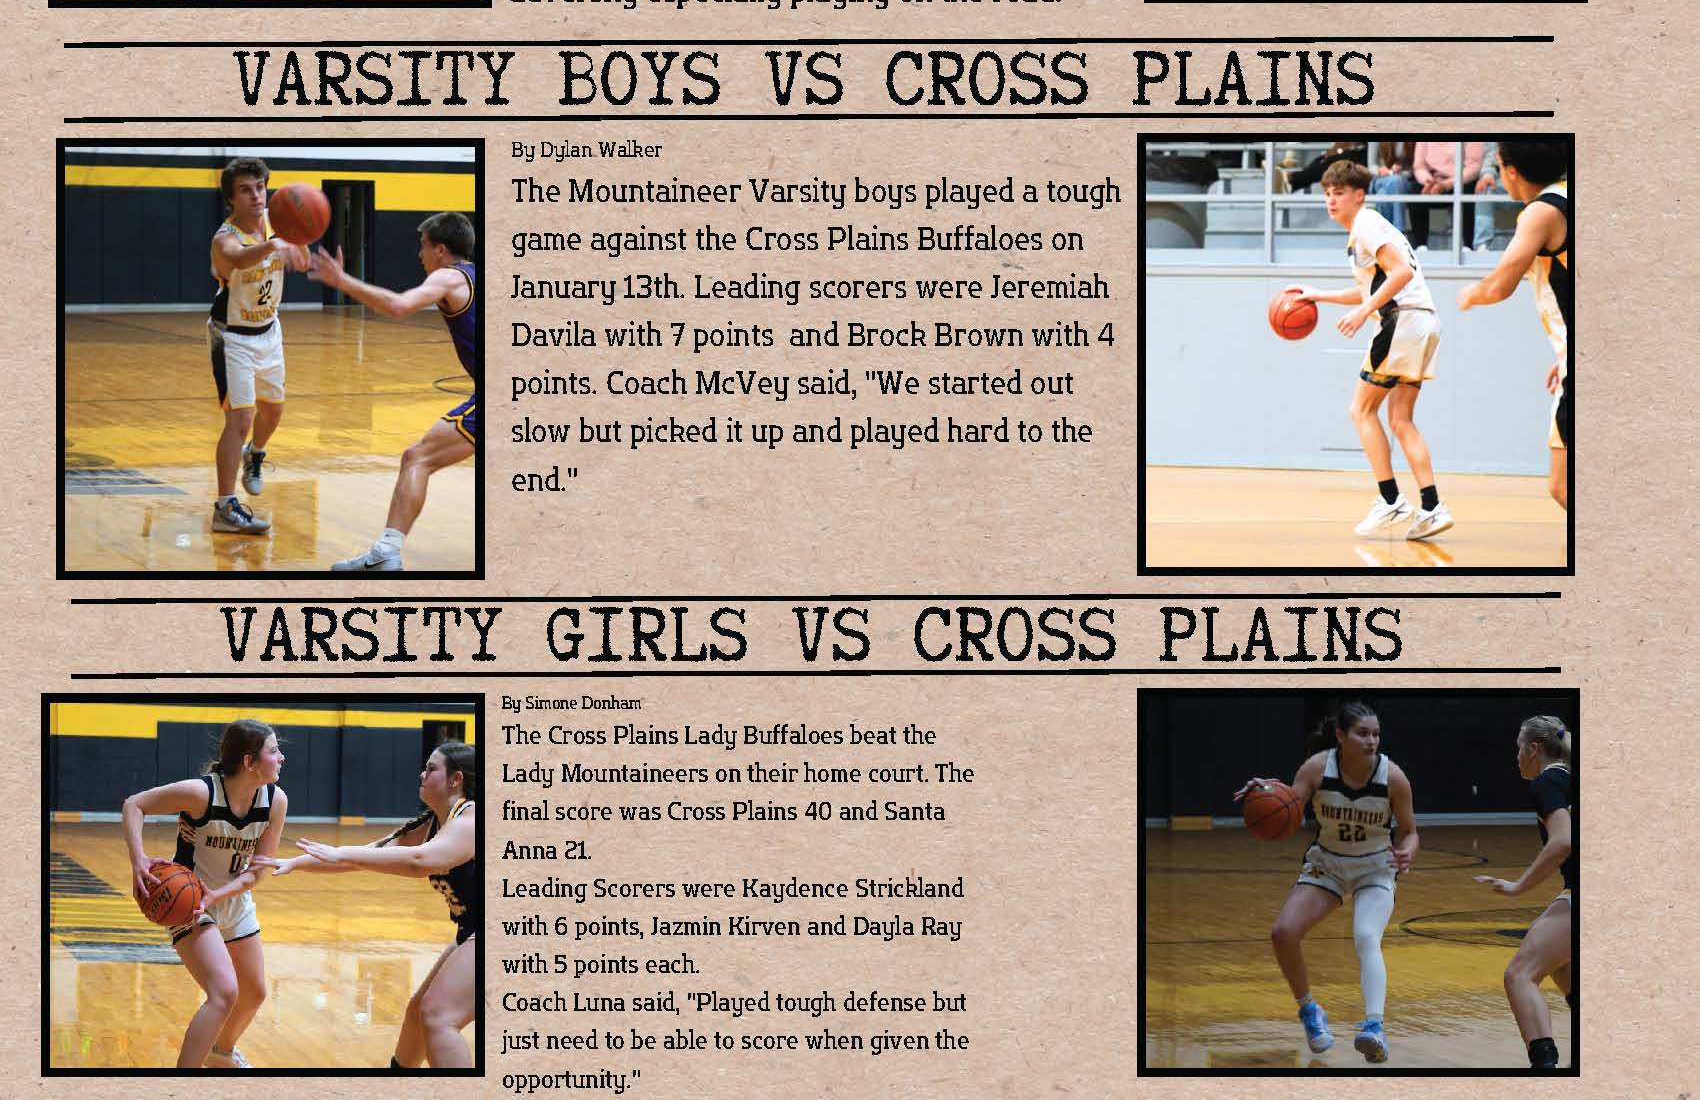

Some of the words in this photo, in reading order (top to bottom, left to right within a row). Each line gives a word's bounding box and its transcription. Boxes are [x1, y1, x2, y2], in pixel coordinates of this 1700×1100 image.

[232, 50, 516, 107] VARSITY
[557, 50, 721, 106] BOYS
[764, 50, 844, 107] VS
[885, 50, 1089, 107] CROSS
[1131, 50, 1375, 107] PLAINS
[511, 141, 536, 163] By
[540, 139, 593, 163] Dylan
[597, 139, 663, 158] Walker
[511, 176, 561, 203] The
[568, 176, 742, 203] Mountaineer
[748, 176, 847, 210] Varsity
[854, 176, 917, 210] boys
[925, 176, 1015, 210] played
[1022, 184, 1039, 203] a
[1046, 176, 1122, 210] tough
[510, 274, 617, 306] January
[623, 272, 685, 299] 13th.
[694, 272, 801, 306] Leading
[809, 280, 907, 299] scorers
[915, 280, 983, 299] were
[990, 272, 1110, 299] Jeremiah
[511, 368, 597, 402] points.
[606, 368, 688, 395] Coach
[695, 370, 790, 402] McVey
[797, 368, 857, 401] said,
[865, 370, 920, 395] "We
[928, 368, 1023, 395] started
[1030, 372, 1074, 395] out
[511, 465, 578, 492] end."
[219, 606, 503, 663] VARSITY
[546, 606, 748, 663] GIRLS
[791, 606, 871, 663] VS
[913, 606, 1117, 663] CROSS
[1158, 606, 1403, 663] PLAINS
[501, 695, 522, 714] By
[525, 695, 578, 710] Simone
[581, 694, 642, 710] Donham
[501, 723, 542, 745] The
[548, 725, 607, 745] Cross
[613, 723, 679, 745] Plains
[684, 723, 738, 751] Lady
[743, 723, 844, 745] Buffaloes
[849, 723, 897, 745] beat
[902, 723, 937, 745] the
[502, 799, 550, 821] final
[555, 806, 613, 821] score
[618, 806, 662, 821] was
[667, 801, 726, 821] Cross
[732, 799, 798, 821] Plains
[804, 801, 832, 821] 40
[839, 799, 879, 821] and
[884, 801, 946, 821] Santa
[1321, 803, 1384, 826] MOUNTAINEERS
[1337, 822, 1367, 842] 22
[501, 840, 558, 860] Anna
[564, 840, 592, 860] 21.
[502, 876, 588, 904] Leading
[593, 878, 676, 898] Scorers
[681, 883, 736, 898] were
[742, 876, 849, 904] Kaydence
[855, 876, 965, 898] Strickland
[501, 952, 549, 974] with
[554, 954, 568, 974] 5
[573, 953, 639, 979] points
[645, 952, 700, 974] each.
[502, 1068, 641, 1095] opportunity."
